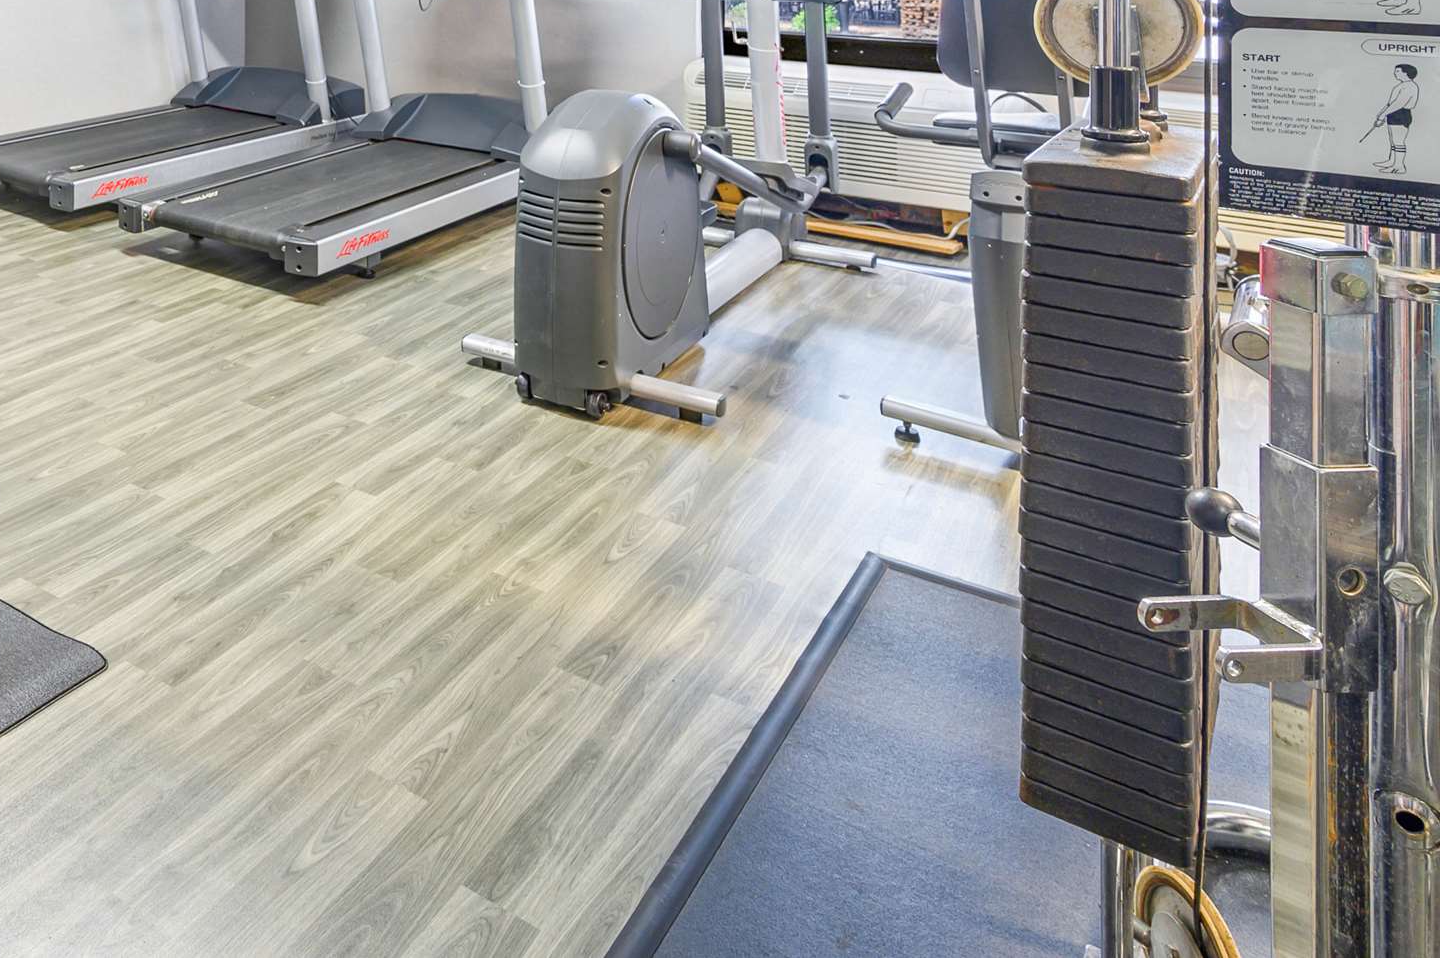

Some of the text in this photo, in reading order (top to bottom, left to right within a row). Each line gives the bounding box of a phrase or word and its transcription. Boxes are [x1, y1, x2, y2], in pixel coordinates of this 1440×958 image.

[1378, 43, 1437, 53] UPRIGHT
[1242, 53, 1280, 62] START
[1228, 166, 1265, 177] CAUTION:
